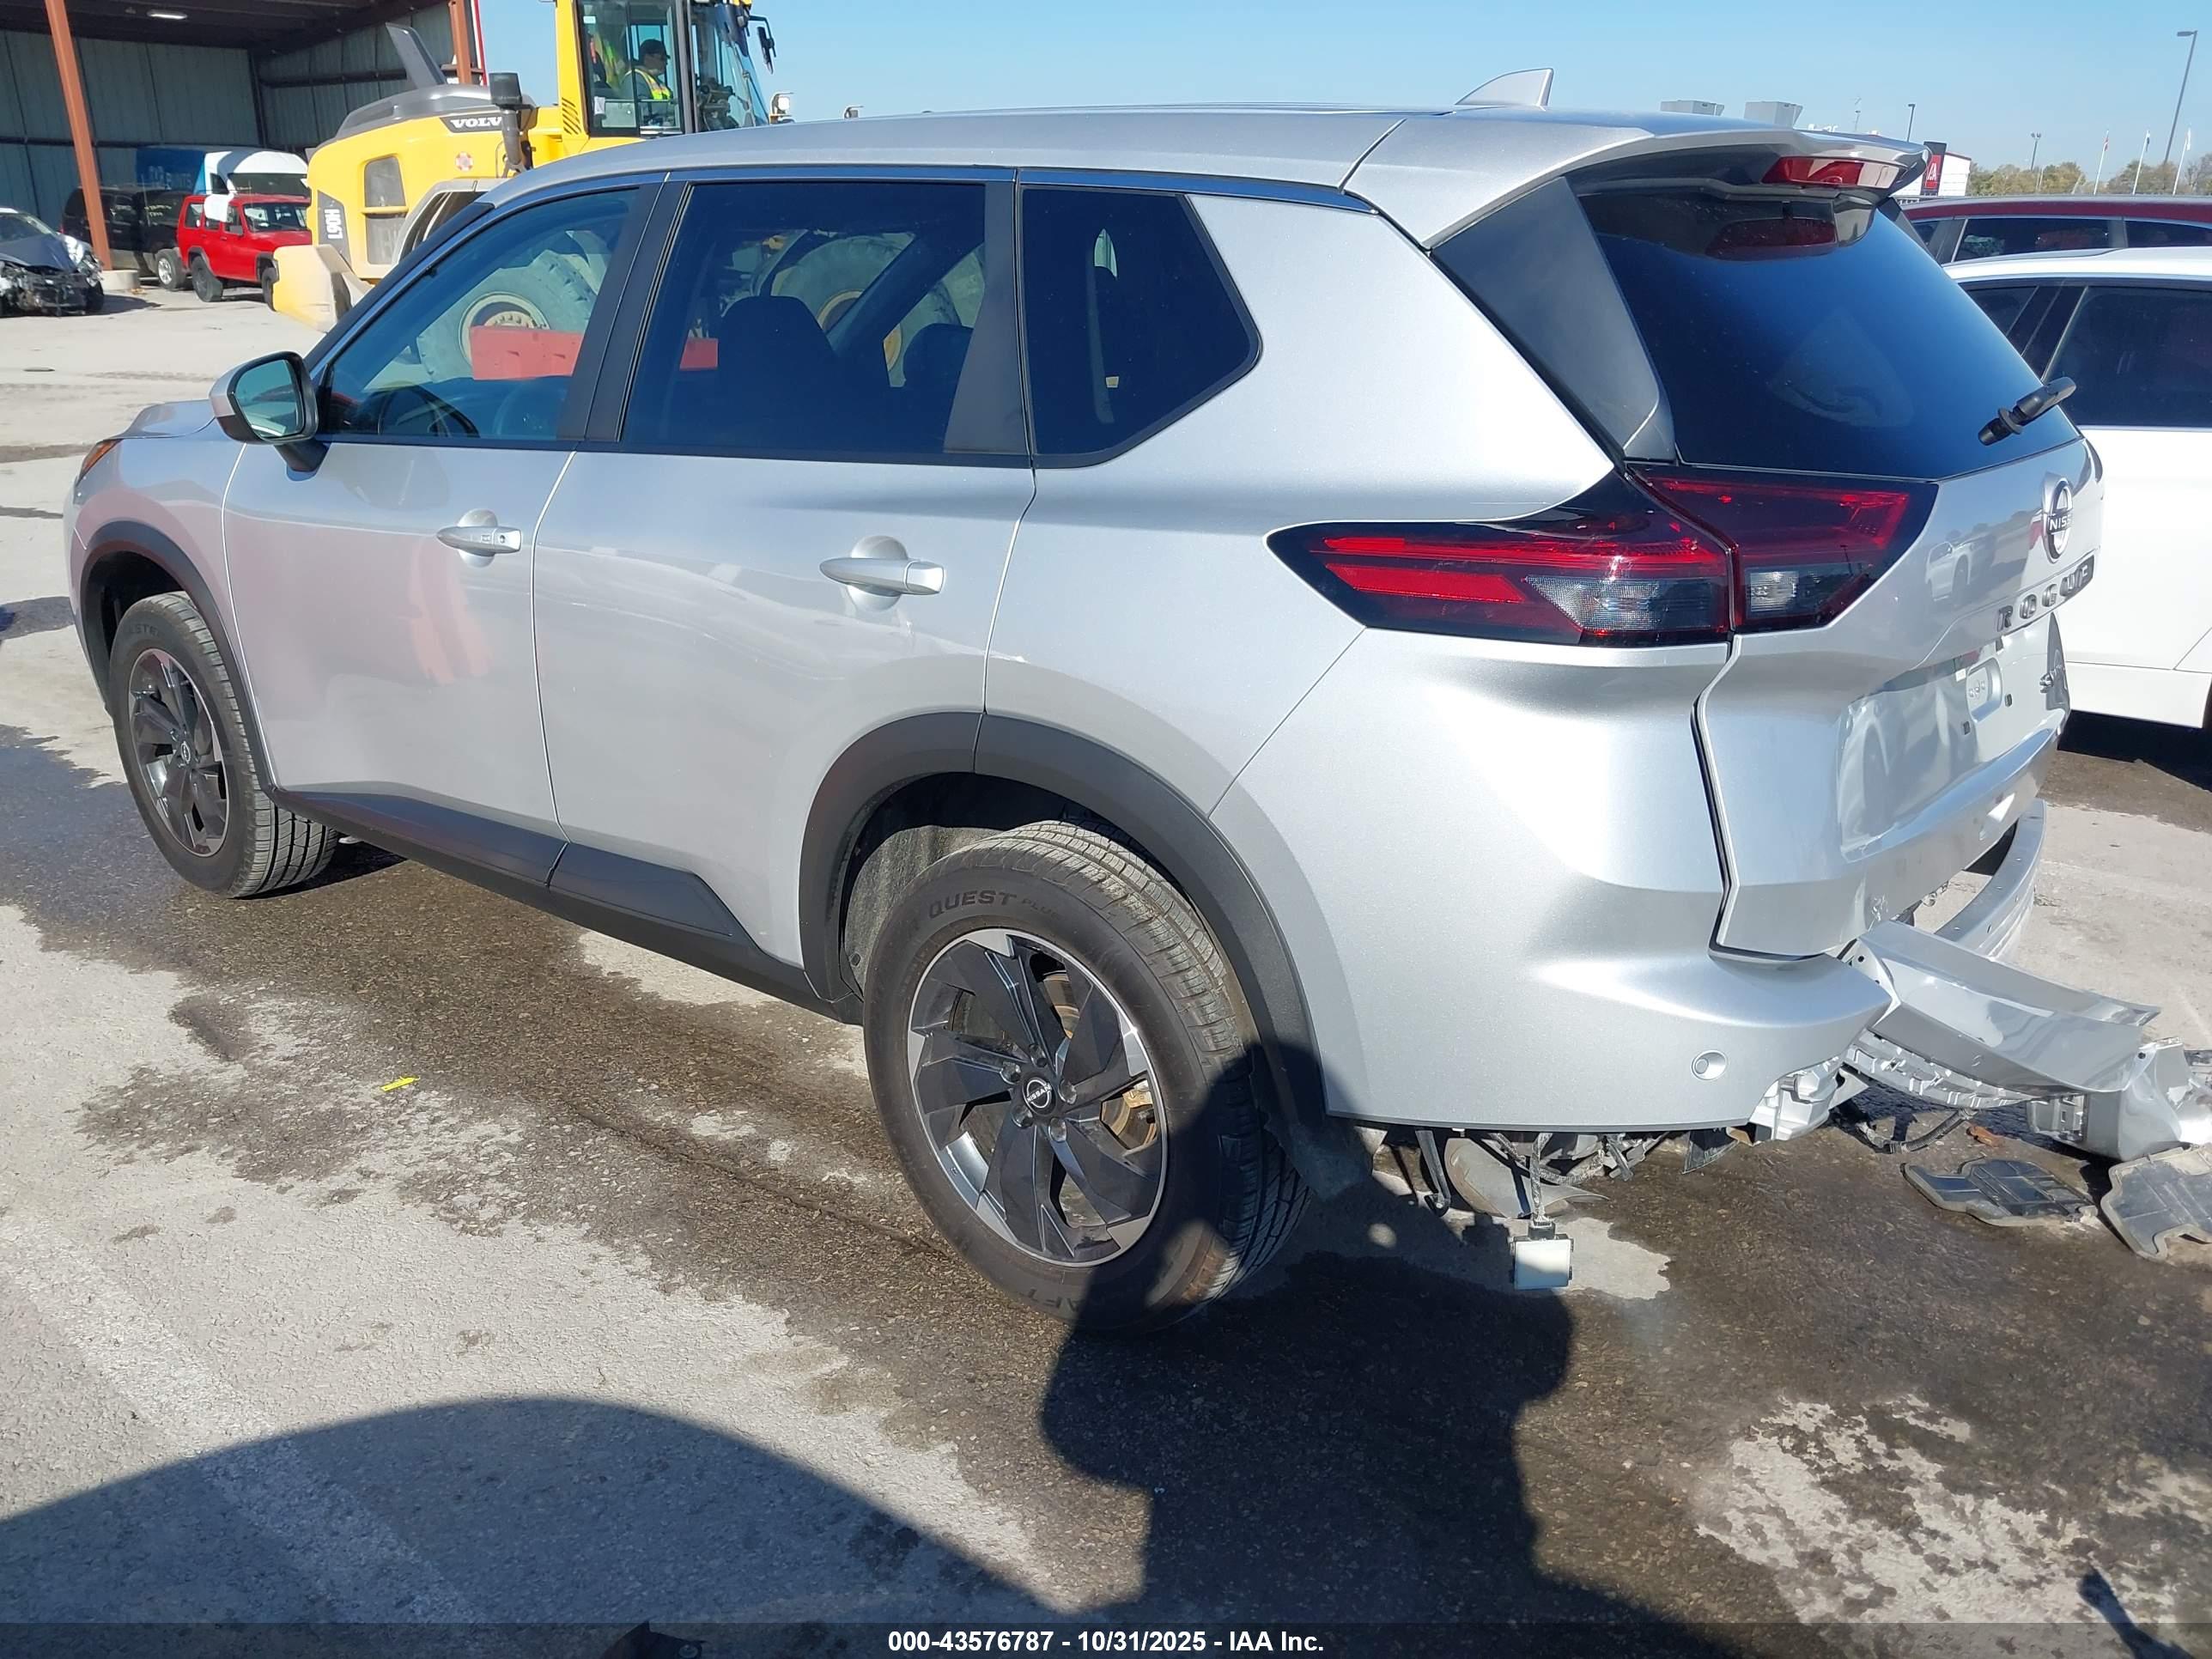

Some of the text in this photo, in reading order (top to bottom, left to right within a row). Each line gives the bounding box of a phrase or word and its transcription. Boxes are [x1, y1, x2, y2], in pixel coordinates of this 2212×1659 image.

[450, 116, 502, 129] VOLV
[2049, 513, 2071, 532] NISS
[1996, 561, 2090, 632] ROGUE
[929, 890, 1018, 919] QUEST
[1026, 1082, 1052, 1103] NISSAN
